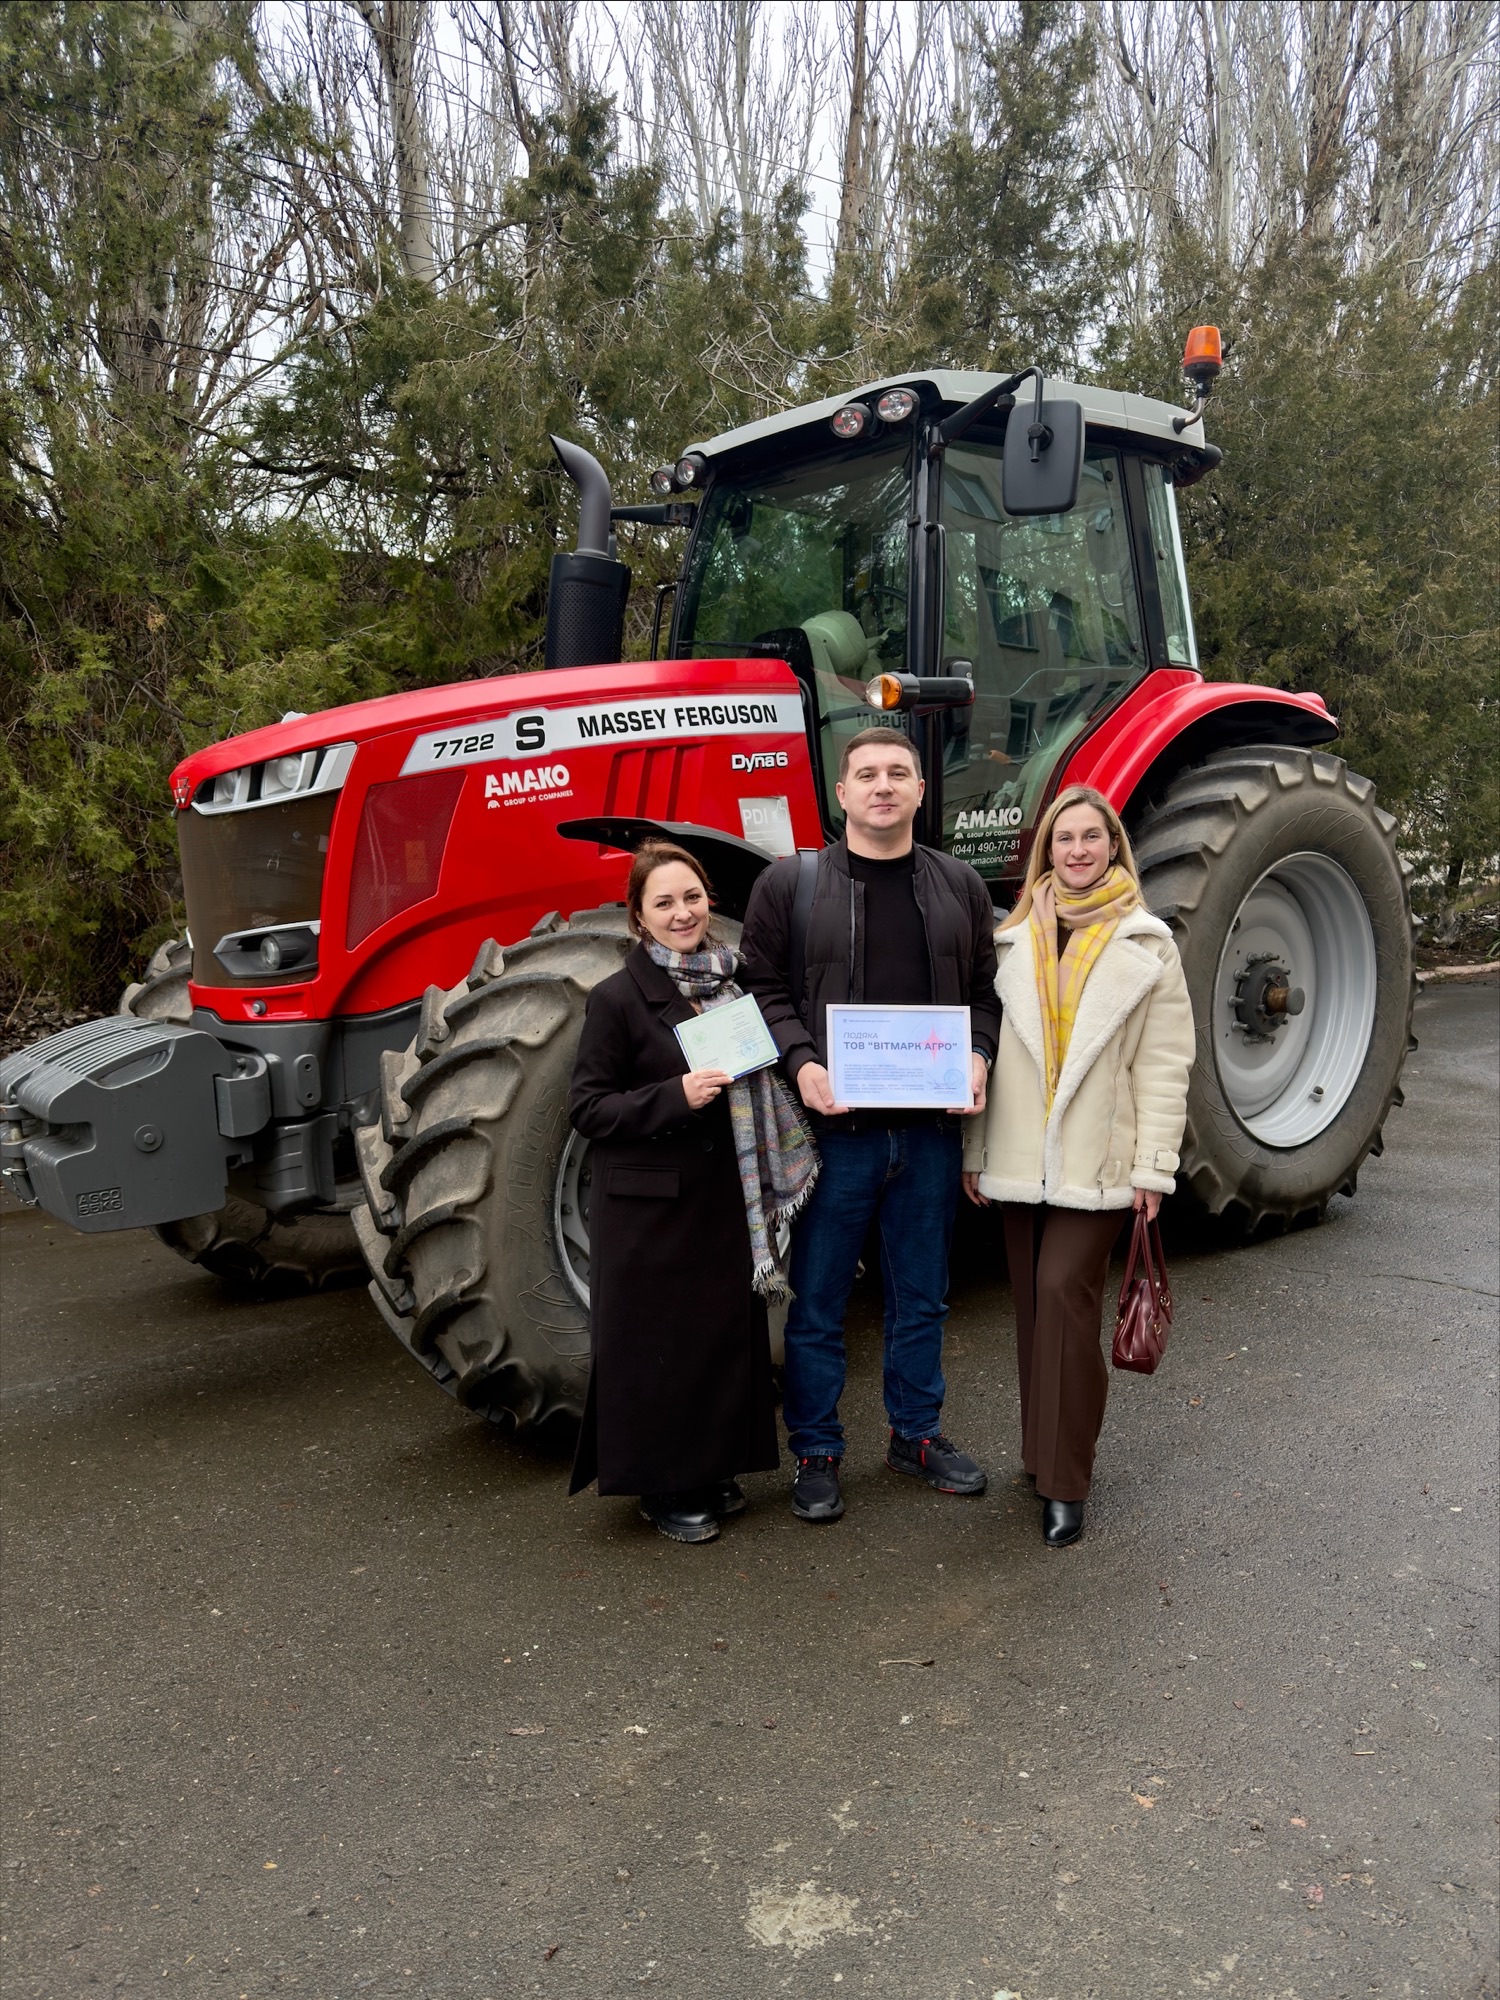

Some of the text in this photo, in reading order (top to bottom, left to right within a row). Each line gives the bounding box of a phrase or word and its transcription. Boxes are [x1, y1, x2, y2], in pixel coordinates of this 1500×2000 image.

[432, 704, 778, 760] 7722 S MASSEY FERGUSON
[484, 763, 570, 798] AMAKO
[503, 789, 574, 807] GROUP OF COMPANIES
[742, 808, 769, 826] PDI
[954, 806, 1022, 830] AMAKO
[993, 828, 1021, 836] COMPANIES
[951, 839, 1020, 858] (044) 490-77-81
[843, 1032, 879, 1040] ПОДЯКА
[843, 1041, 865, 1050] ТОВ
[78, 1188, 120, 1205] AGCO
[78, 1198, 122, 1214] 55KG
